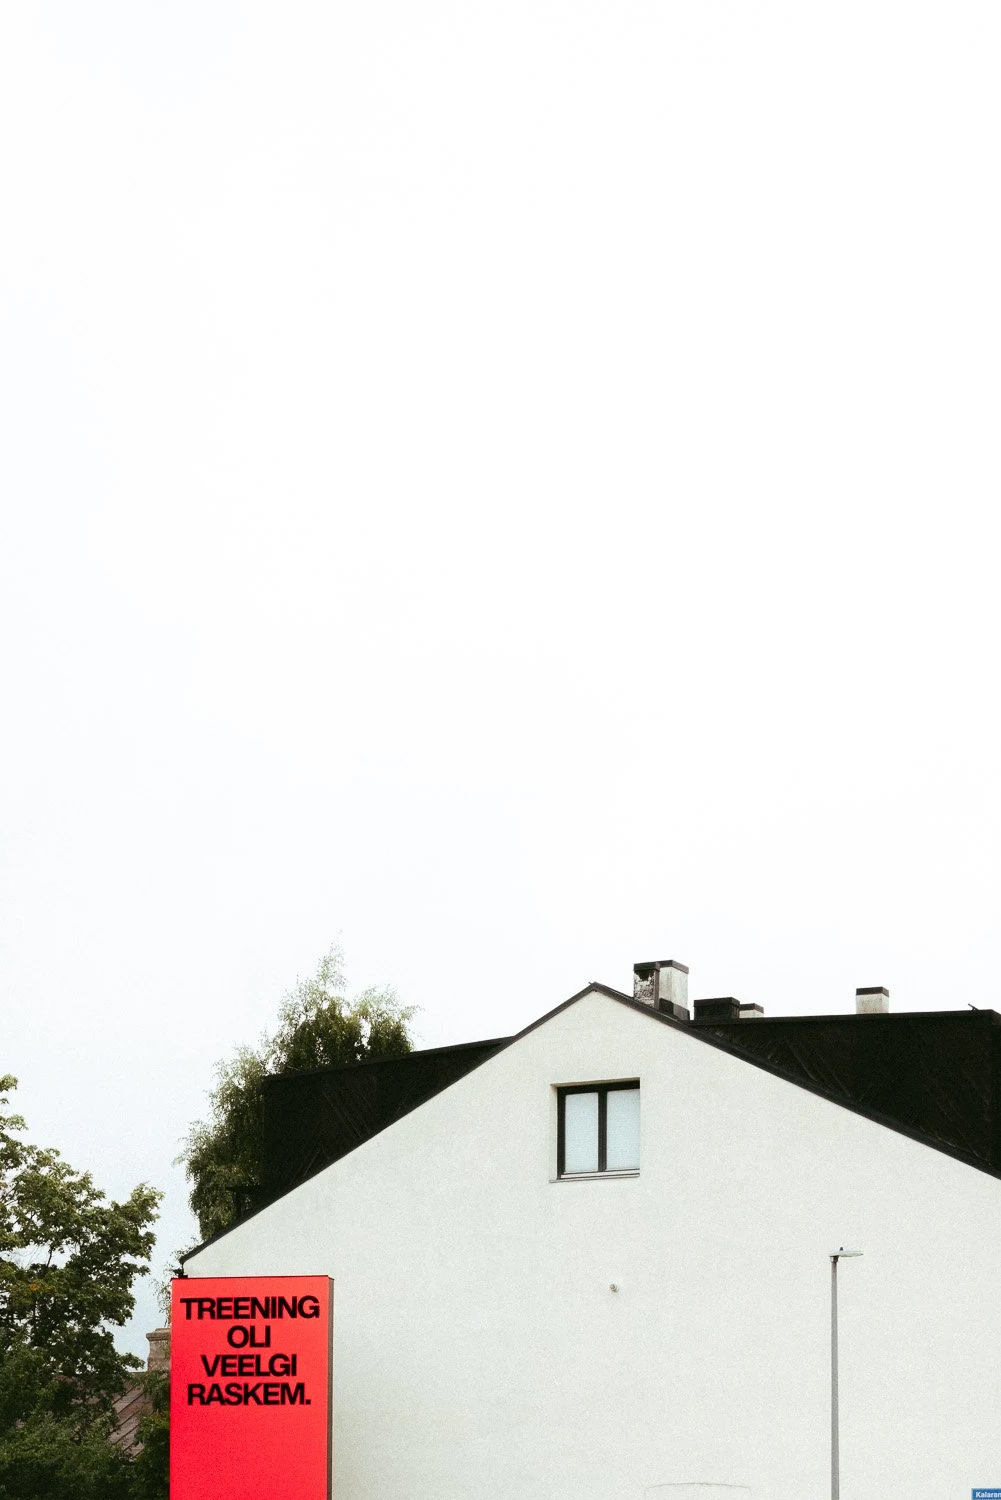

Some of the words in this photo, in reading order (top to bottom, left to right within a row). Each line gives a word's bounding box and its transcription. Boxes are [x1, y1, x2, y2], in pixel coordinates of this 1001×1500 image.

[179, 1295, 320, 1320] TREENING
[227, 1325, 271, 1349] OLI
[201, 1353, 297, 1377] VEELGI
[187, 1382, 312, 1406] RASKEM.
